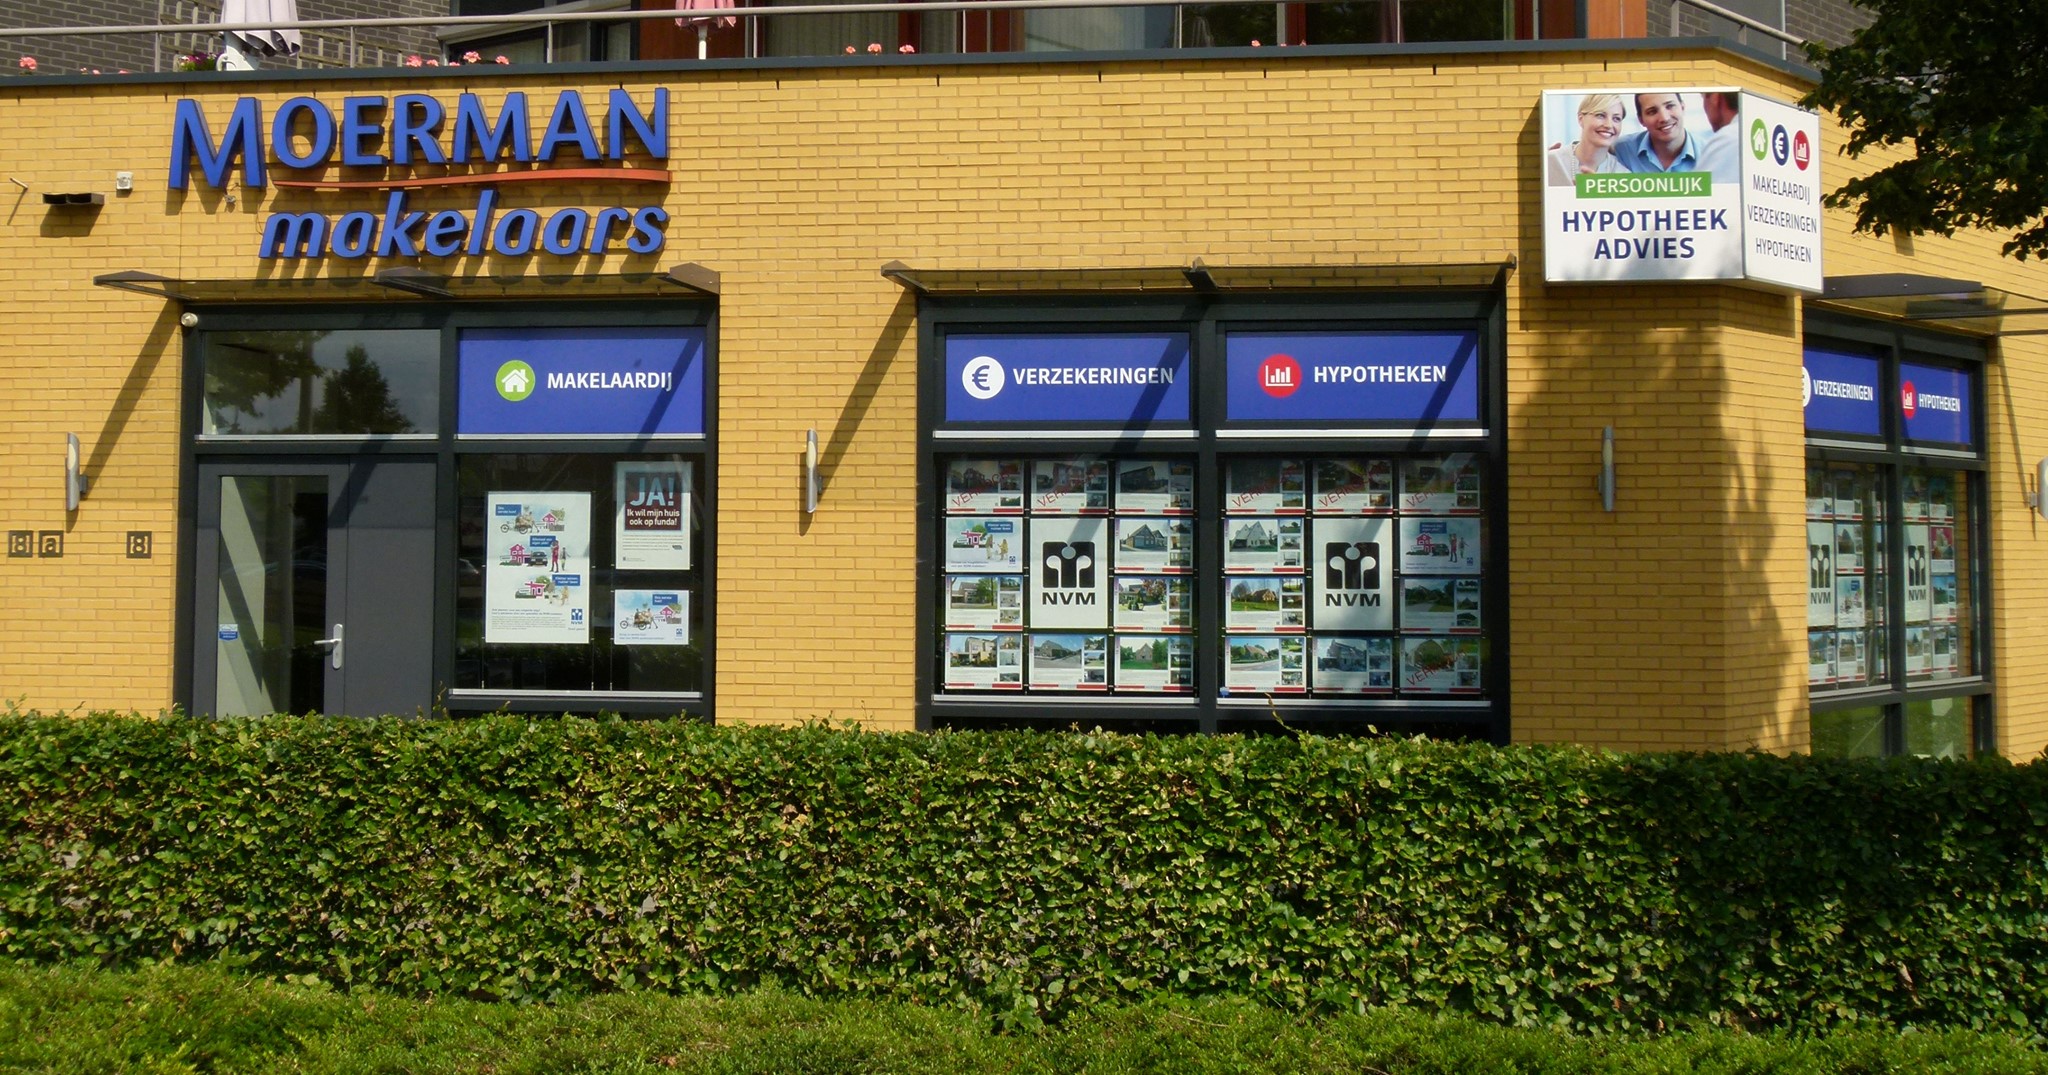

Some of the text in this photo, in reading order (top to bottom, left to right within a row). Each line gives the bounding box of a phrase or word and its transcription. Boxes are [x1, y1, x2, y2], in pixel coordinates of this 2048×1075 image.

[168, 87, 671, 189] MOERMAN
[1585, 176, 1703, 195] PERSOONLIJK
[1752, 174, 1811, 205] MAKELAARDIJ
[259, 189, 670, 259] makelaars
[1562, 208, 1728, 233] HYPOTHEEK
[1747, 203, 1817, 234] VERZEKERINGEN
[1593, 237, 1696, 260] ADVIES
[1755, 237, 1812, 263] HYPOTHEKEN
[547, 372, 672, 392] MAKELAARDIJ
[1013, 367, 1174, 385] VERZEKERINGEN
[1313, 365, 1447, 383] HYPOTHEKEN
[1813, 379, 1873, 401] VERZEKERINGEN
[1918, 393, 1961, 412] HYPOTHEKEN
[630, 477, 675, 506] JA!
[626, 509, 680, 519] Ik wil mijn huis
[629, 518, 678, 527] ook op funda!
[1041, 592, 1096, 605] NVM
[1325, 593, 1381, 607] NVM
[1810, 591, 1832, 604] NVM
[1908, 589, 1927, 601] NVM
